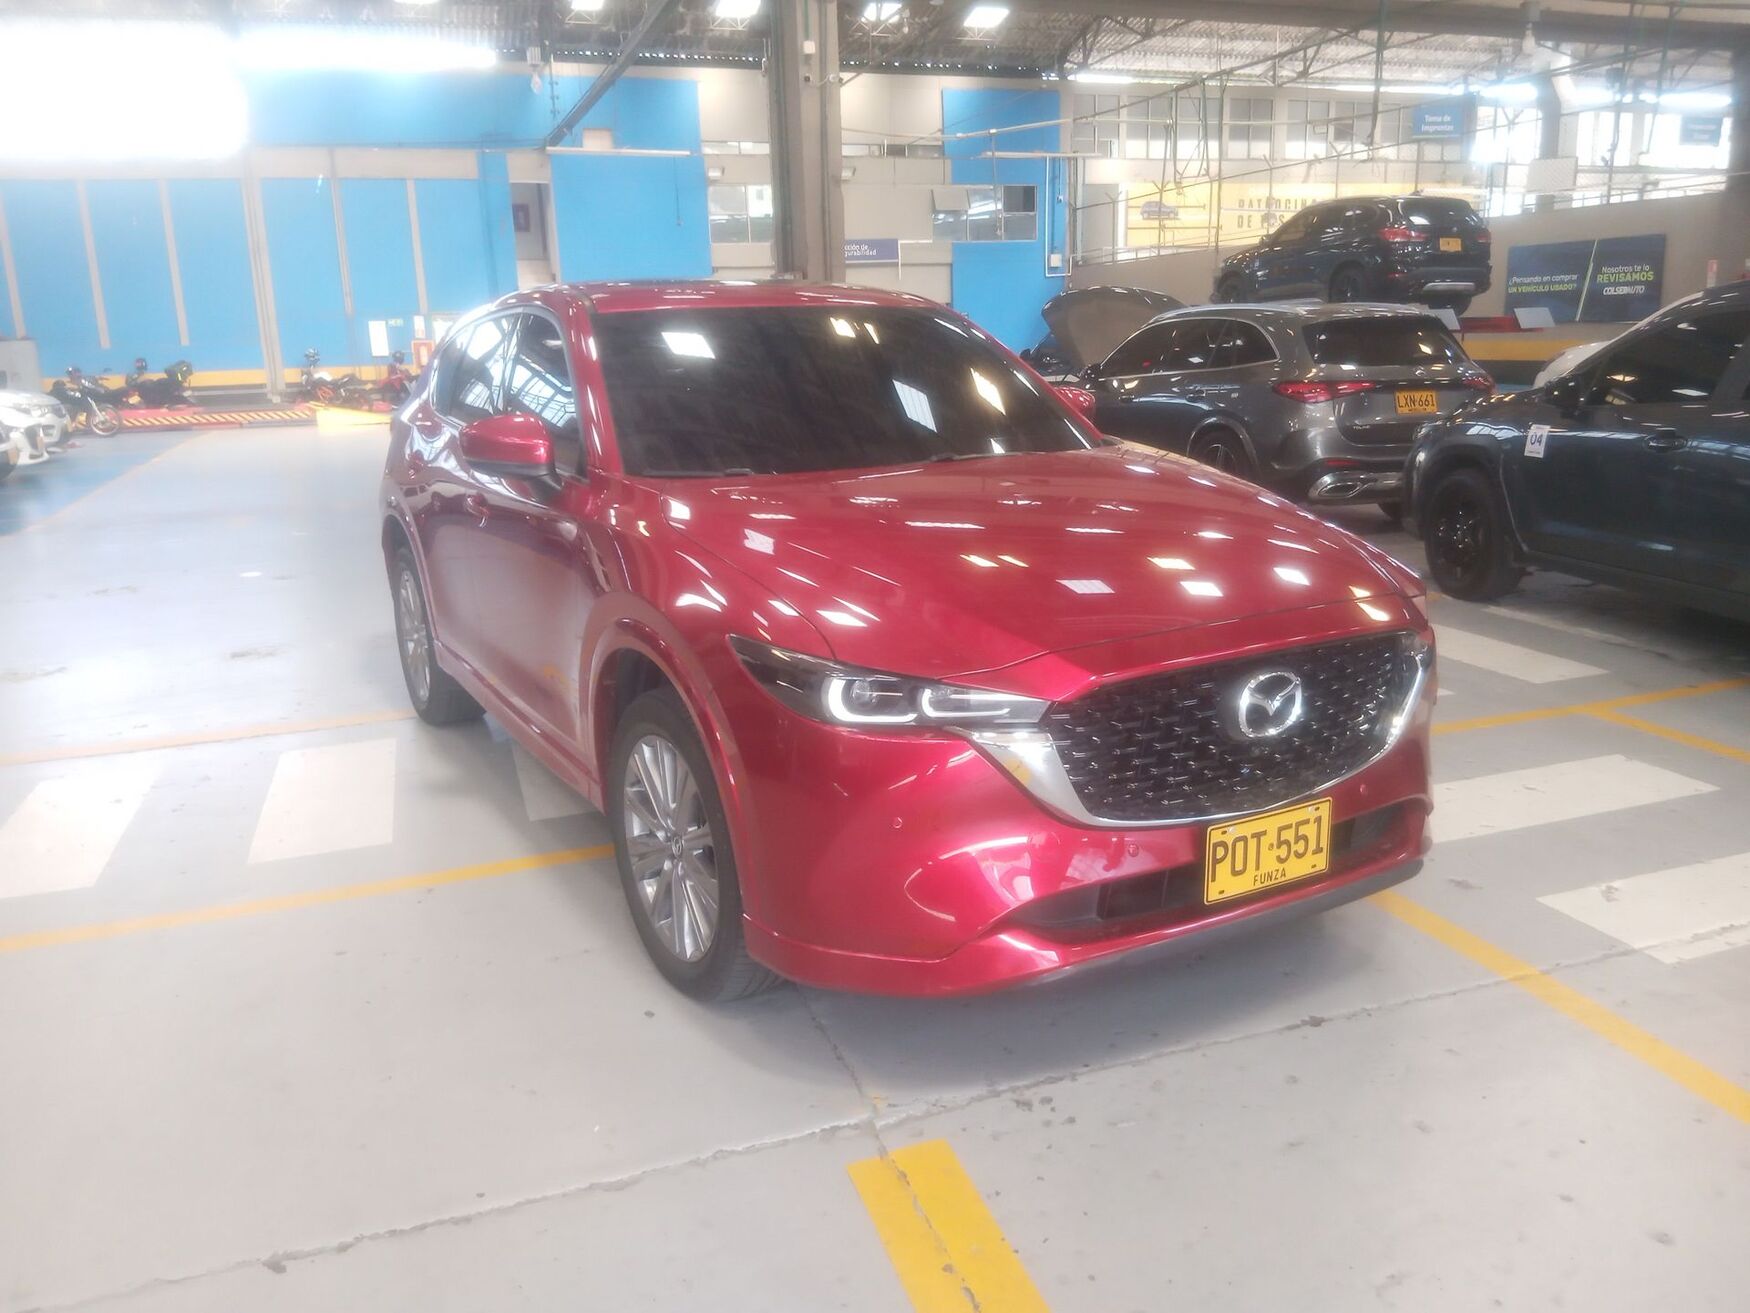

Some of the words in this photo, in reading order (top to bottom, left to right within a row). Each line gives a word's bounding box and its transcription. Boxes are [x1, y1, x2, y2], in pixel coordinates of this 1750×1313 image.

[844, 249, 876, 257] gurabilidad
[1602, 265, 1633, 274] Nosotros
[1634, 264, 1642, 272] te
[1643, 263, 1650, 271] lo
[1508, 275, 1542, 286] ¿Pensando
[1551, 273, 1578, 283] comprar
[1596, 272, 1655, 283] REVISAMOS
[1508, 285, 1517, 294] UN
[1550, 282, 1577, 291] USADO?
[1530, 433, 1543, 447] 04
[1252, 867, 1287, 887] FUNZA
